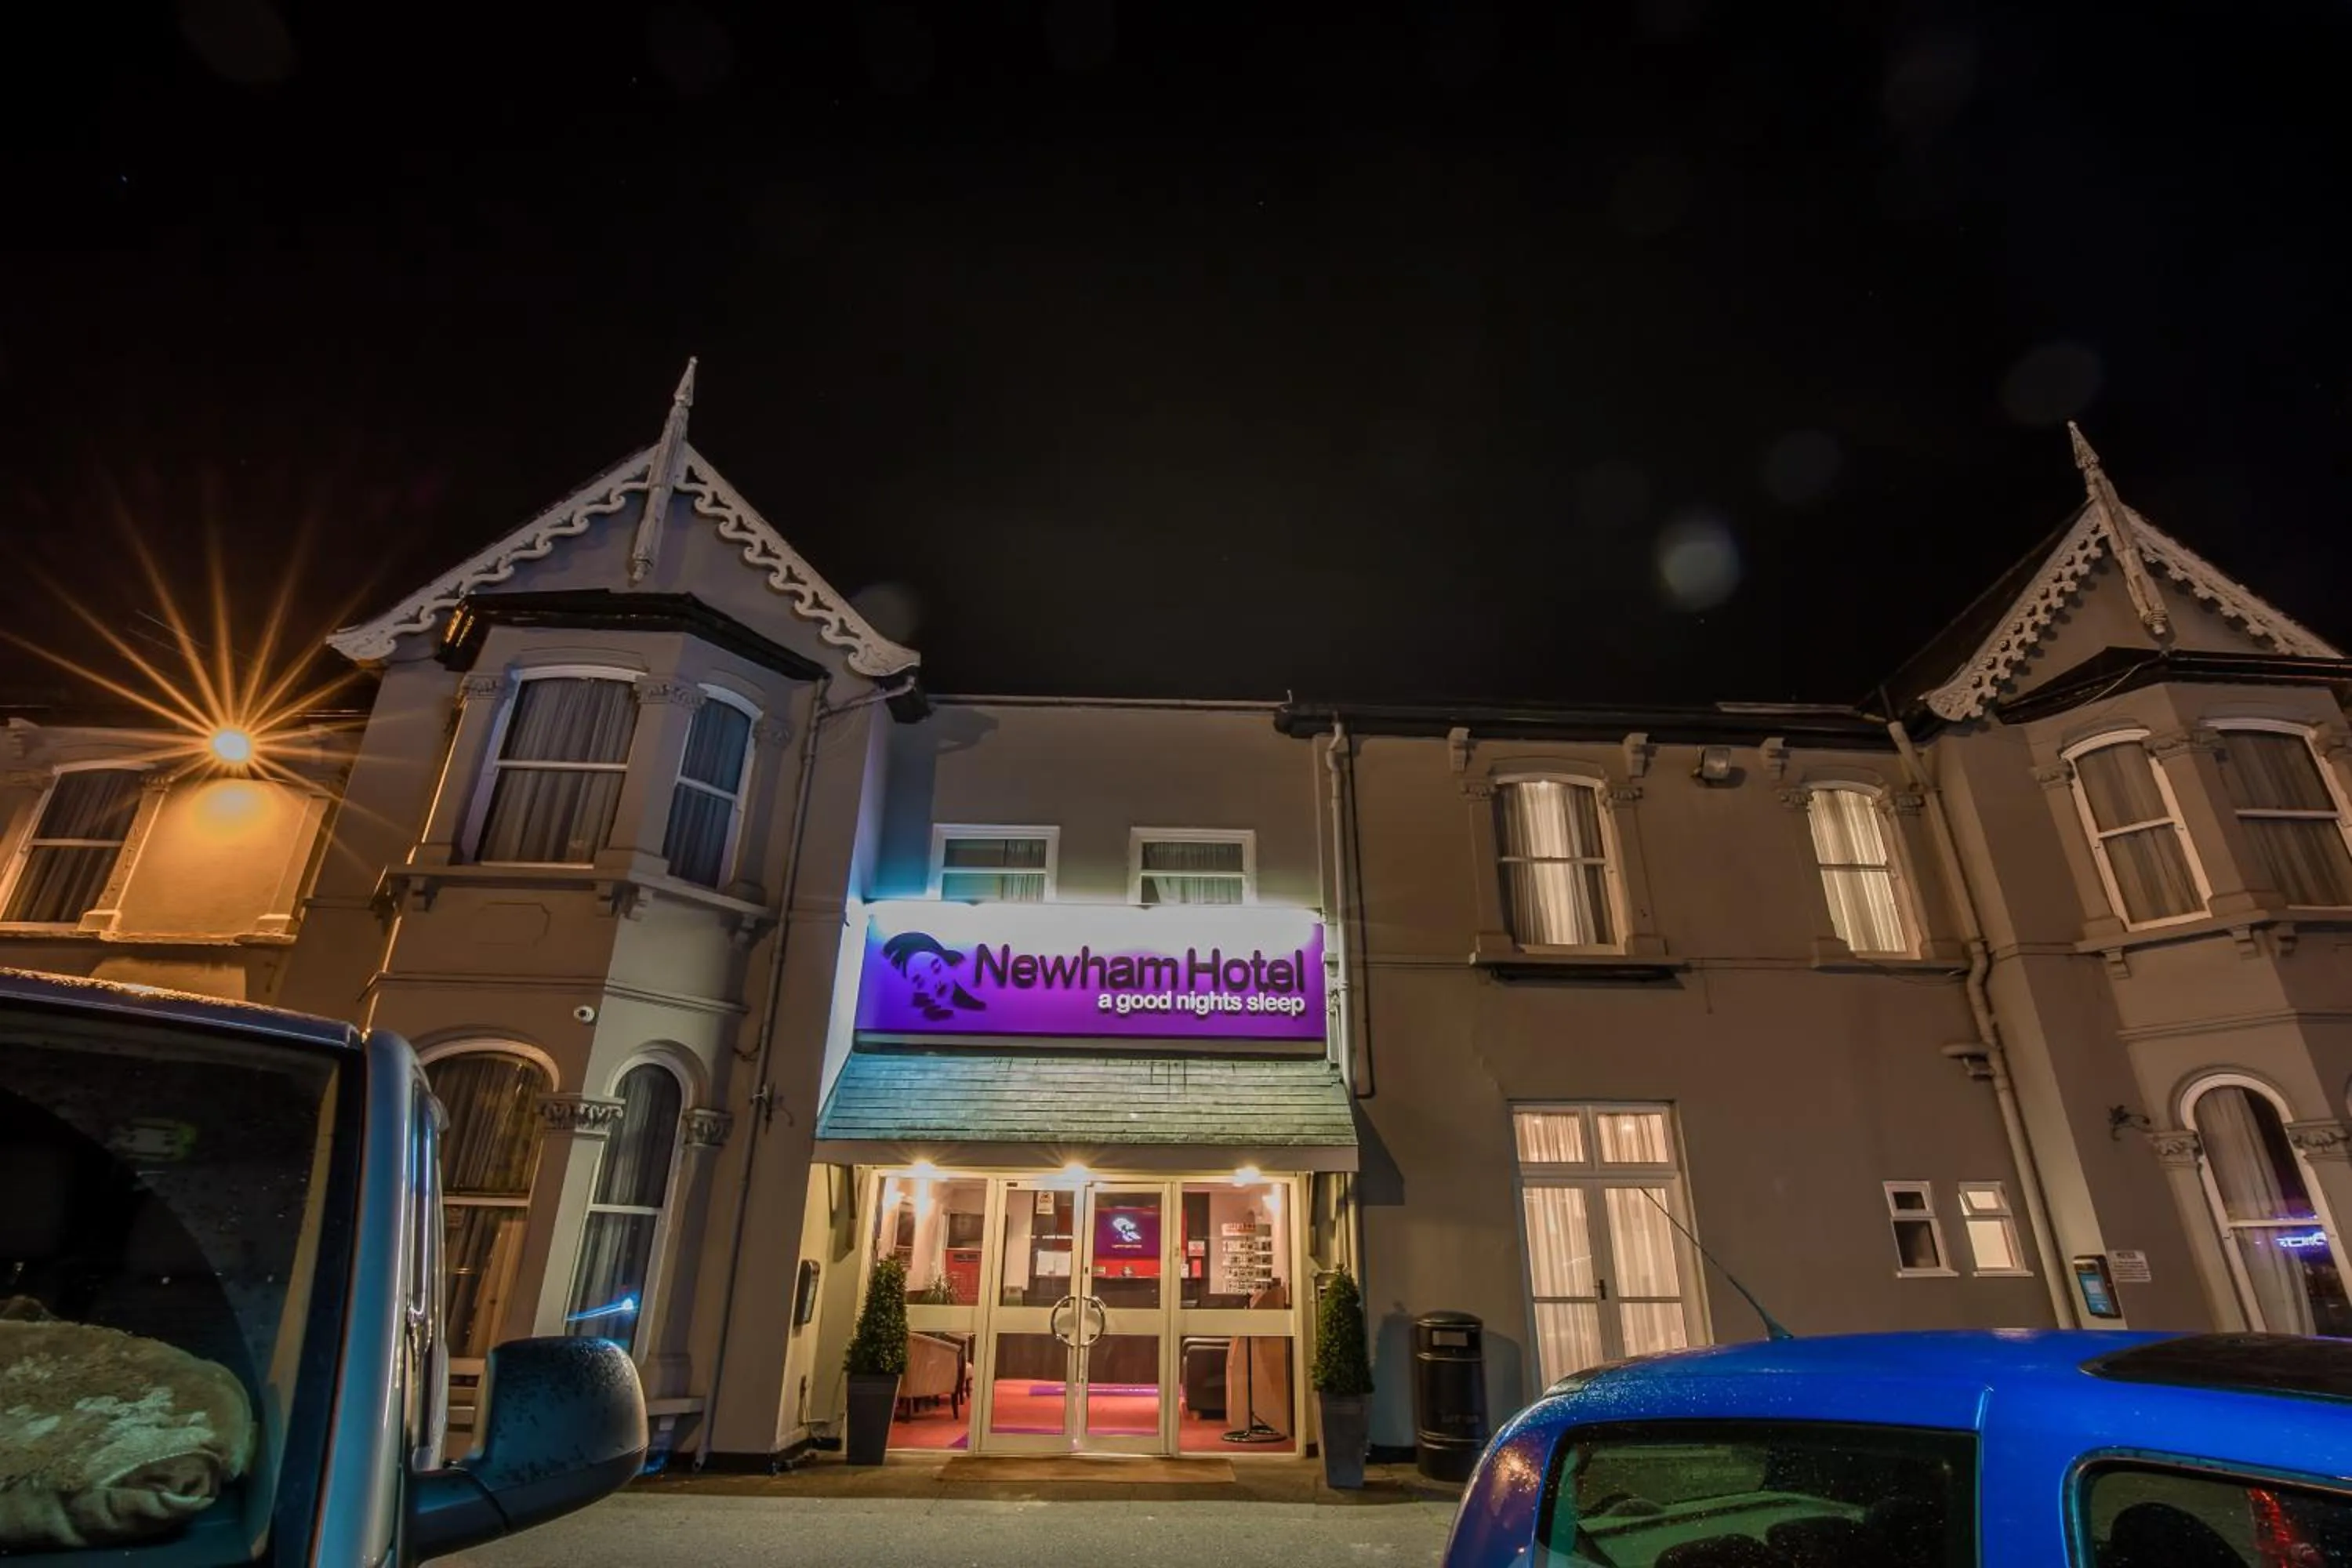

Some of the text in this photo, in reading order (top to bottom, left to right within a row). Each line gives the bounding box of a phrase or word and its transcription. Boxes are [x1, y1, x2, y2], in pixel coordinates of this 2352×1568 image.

[974, 943, 1305, 993] Newham Hotel
[1098, 991, 1305, 1016] a good nights sleep
